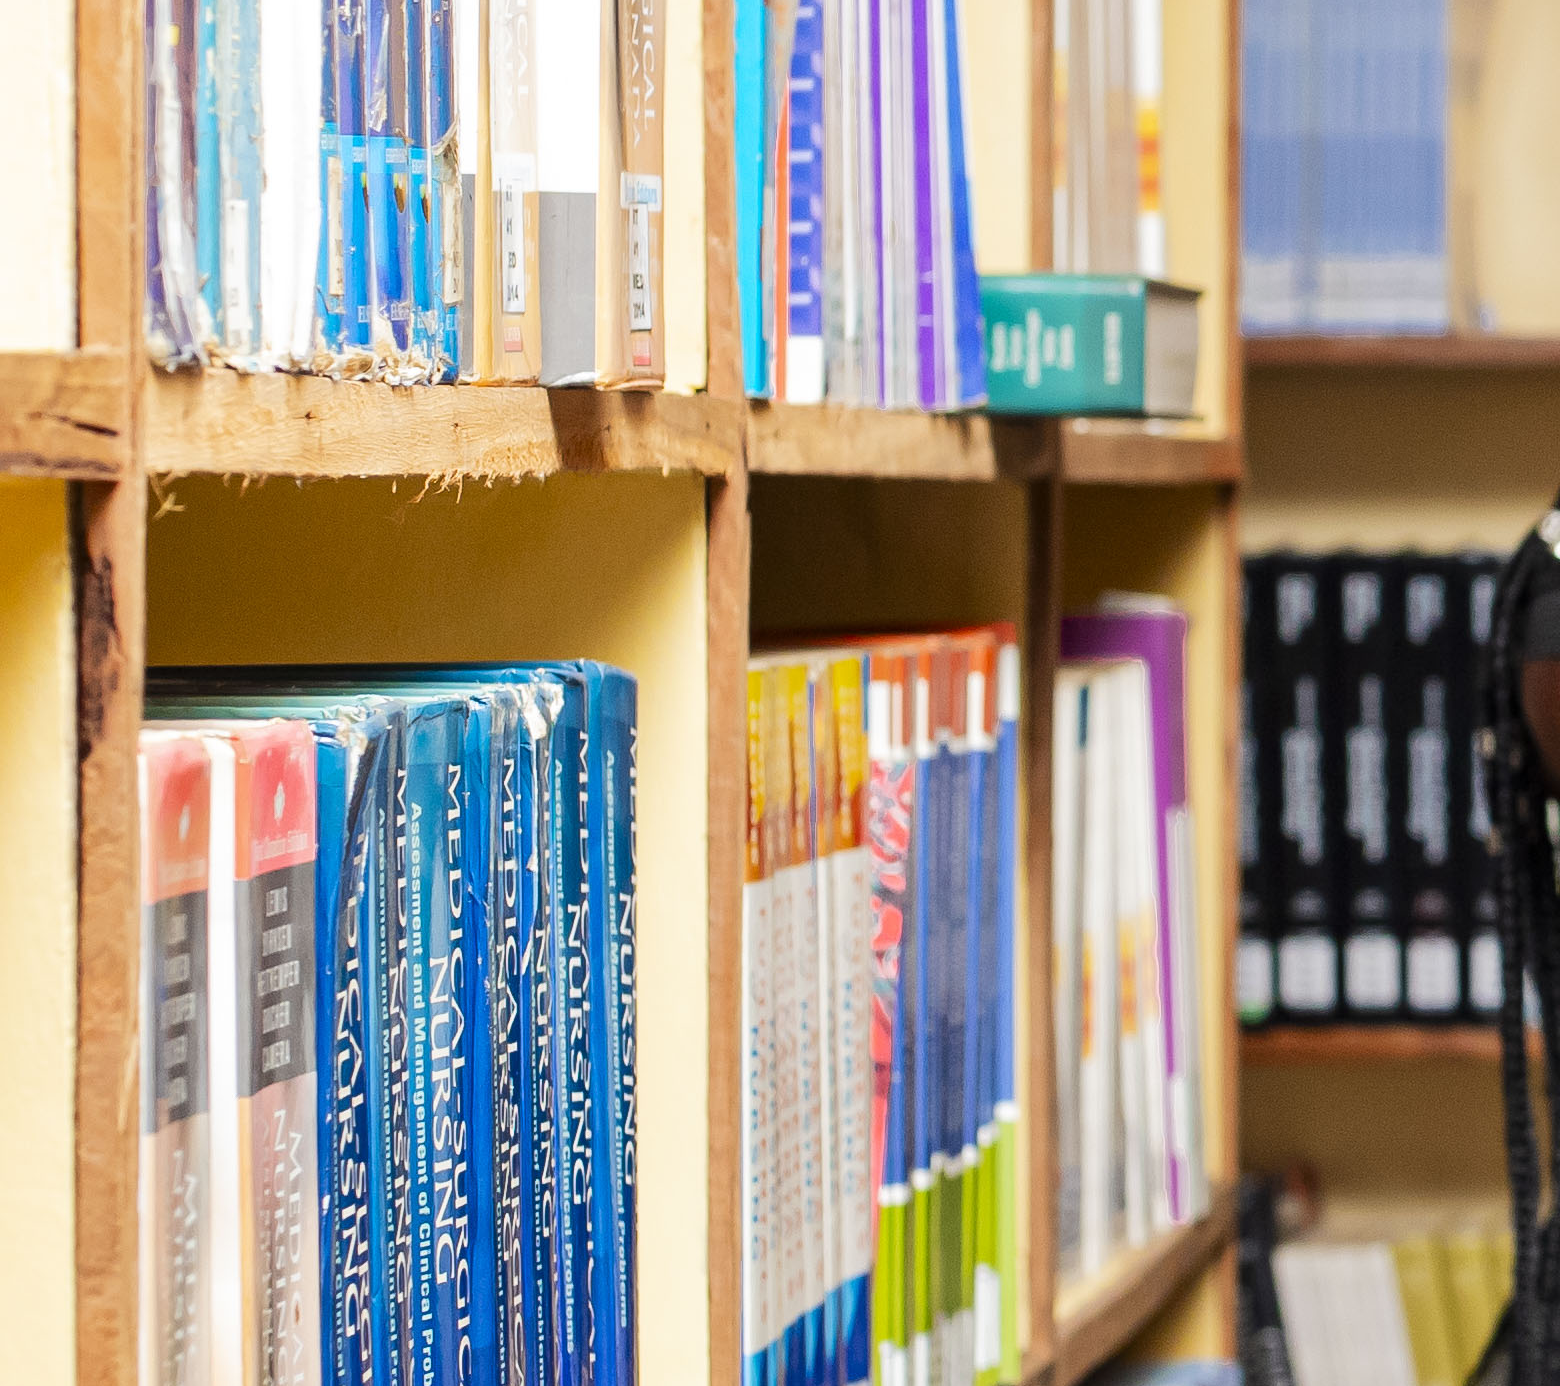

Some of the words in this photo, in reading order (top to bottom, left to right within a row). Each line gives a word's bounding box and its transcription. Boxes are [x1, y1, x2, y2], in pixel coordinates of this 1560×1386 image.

[411, 802, 422, 958] Assessment
[413, 962, 424, 1009] and
[411, 1018, 427, 1185] Management
[430, 956, 455, 1285] NURSING
[418, 1192, 427, 1210] of
[419, 1221, 431, 1322] Clinical
